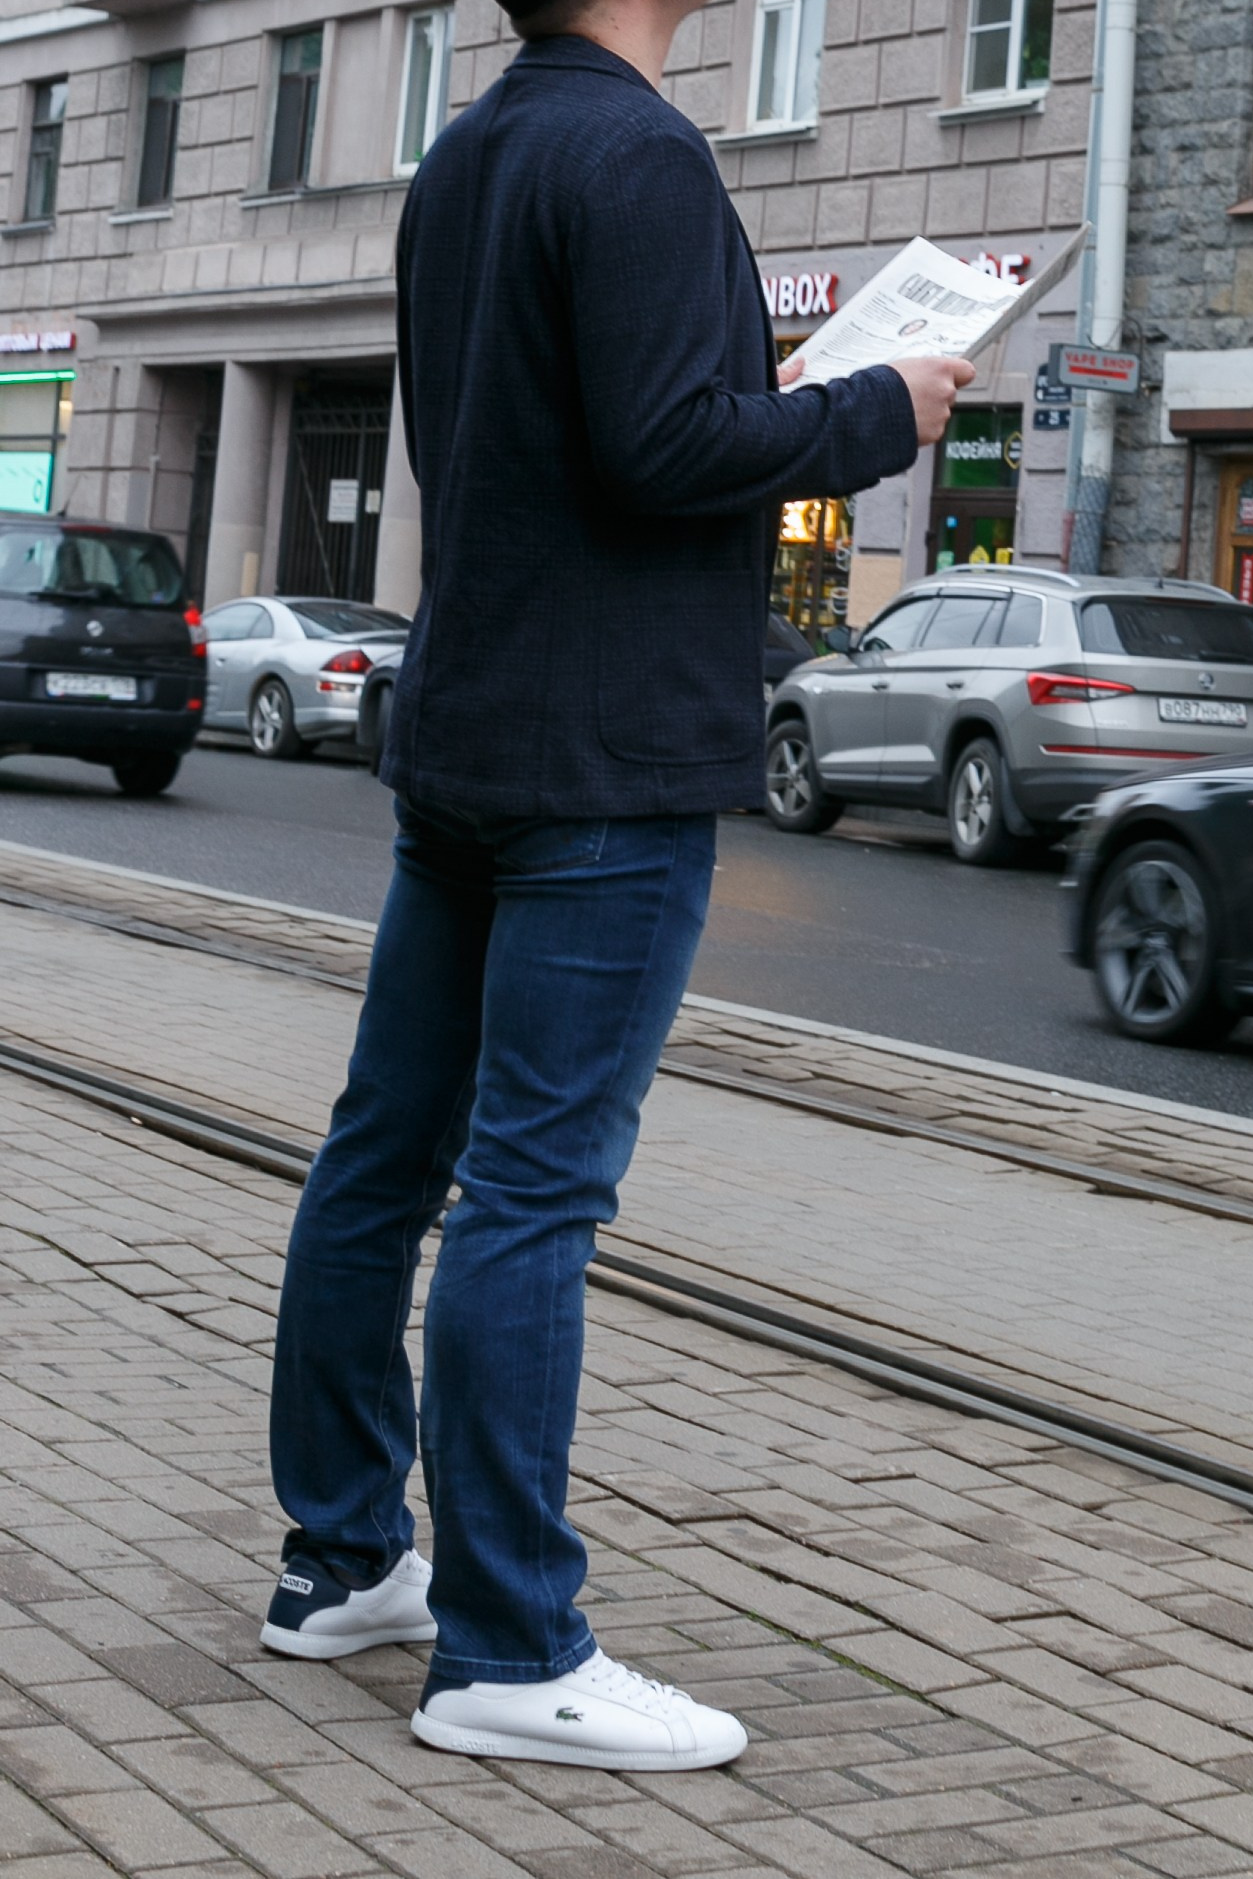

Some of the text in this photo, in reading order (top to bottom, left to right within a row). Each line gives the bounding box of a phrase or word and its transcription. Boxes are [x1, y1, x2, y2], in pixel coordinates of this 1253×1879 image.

[1065, 351, 1135, 370] VAPE SHOP
[946, 436, 1002, 460] КОФЕЙНЯ
